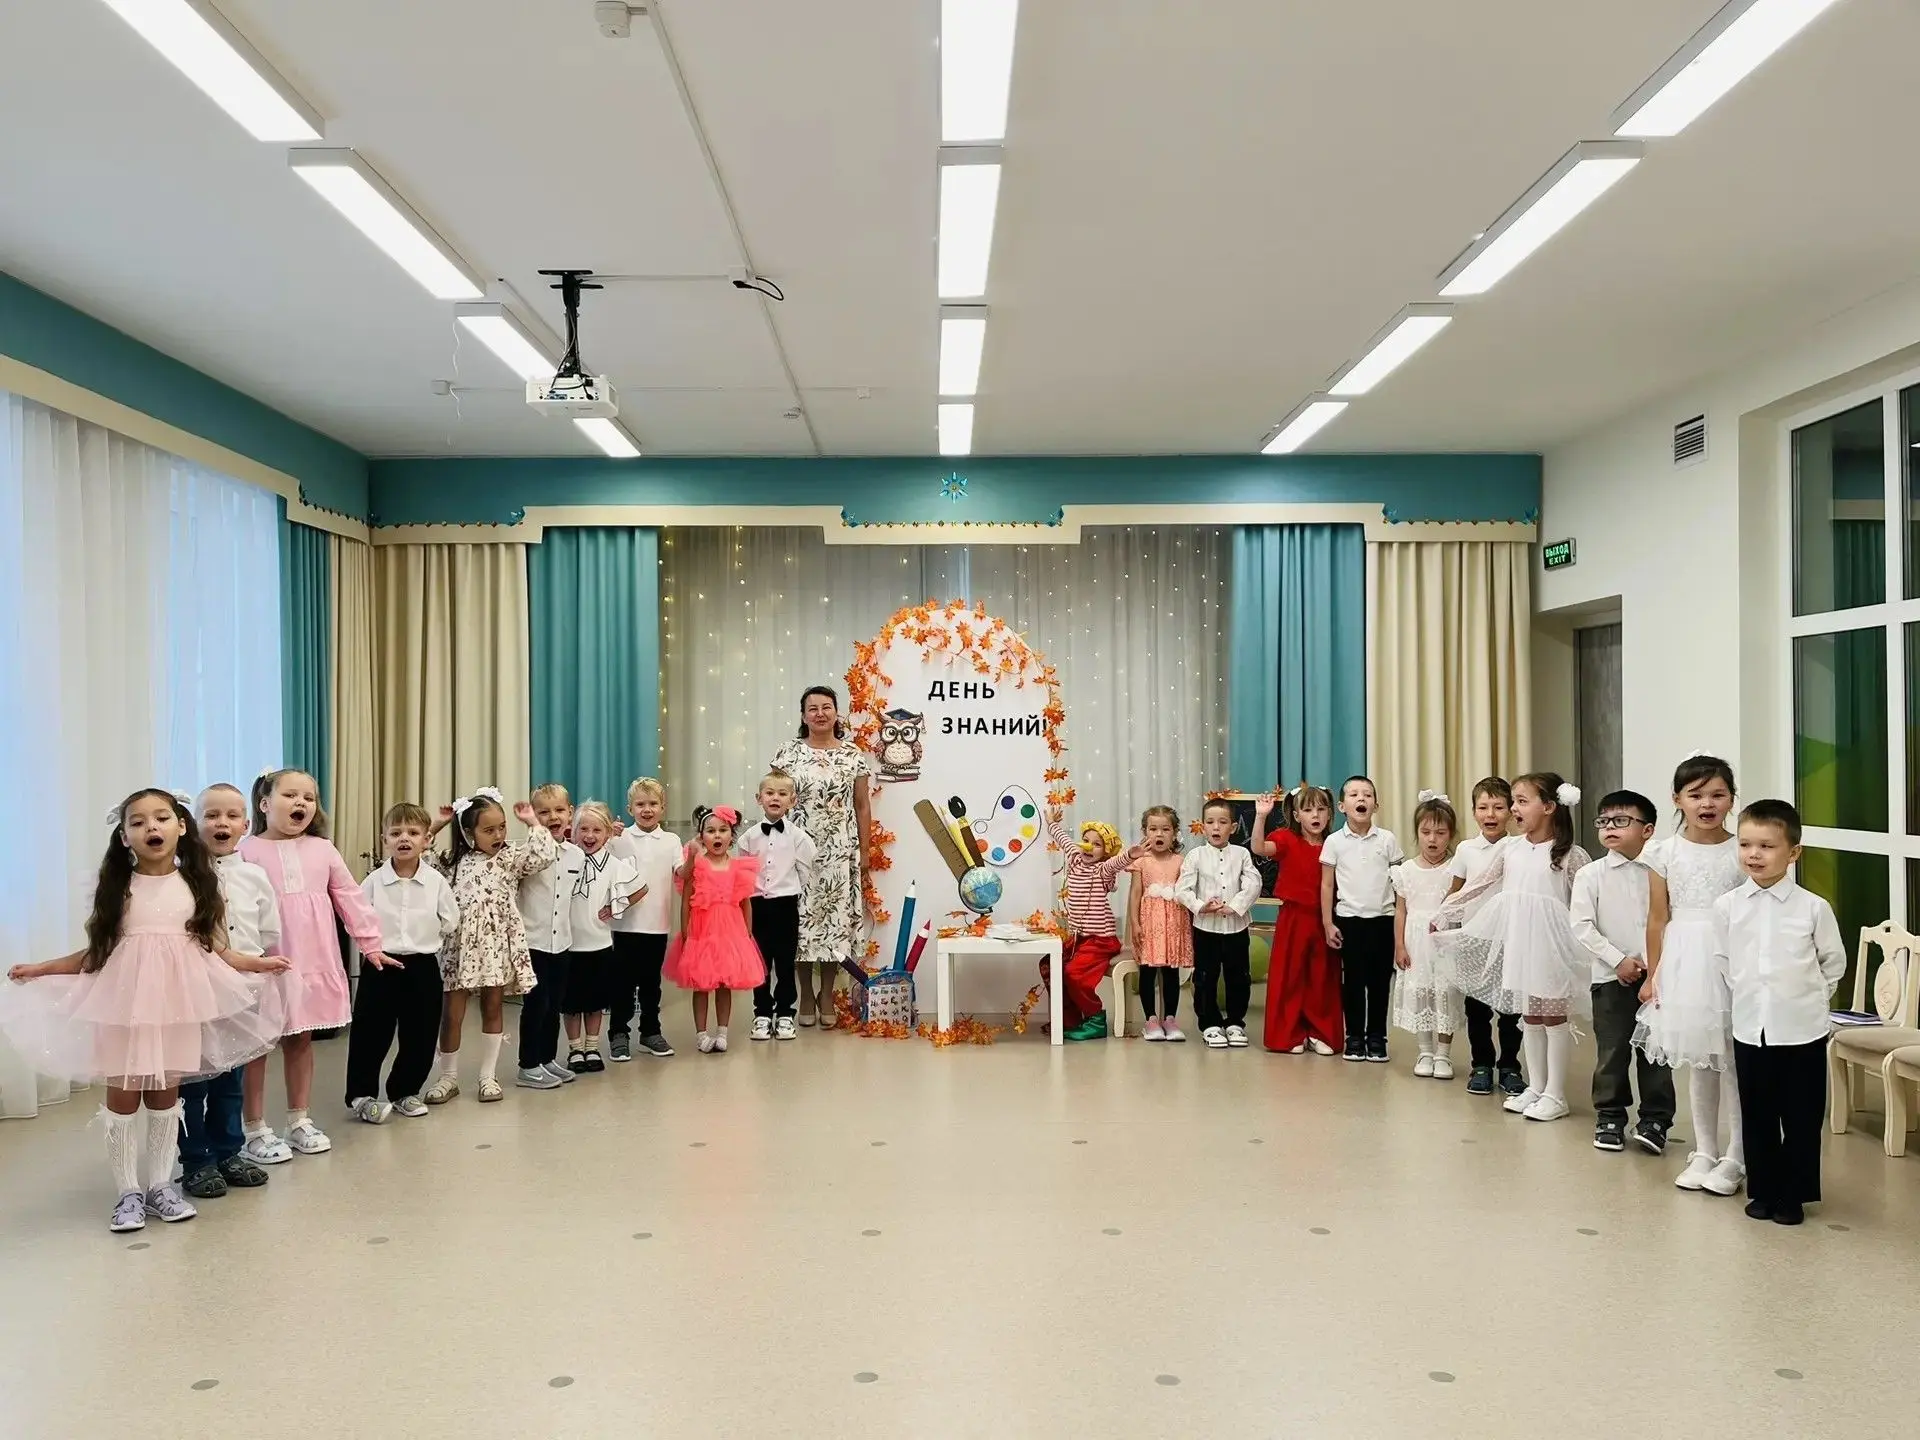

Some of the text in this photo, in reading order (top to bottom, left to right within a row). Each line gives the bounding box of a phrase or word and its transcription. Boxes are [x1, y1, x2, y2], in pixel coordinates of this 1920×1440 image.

[1545, 543, 1569, 558] ВЫХОД
[1549, 554, 1566, 565] EXIT
[928, 680, 995, 701] ДЕНЬ
